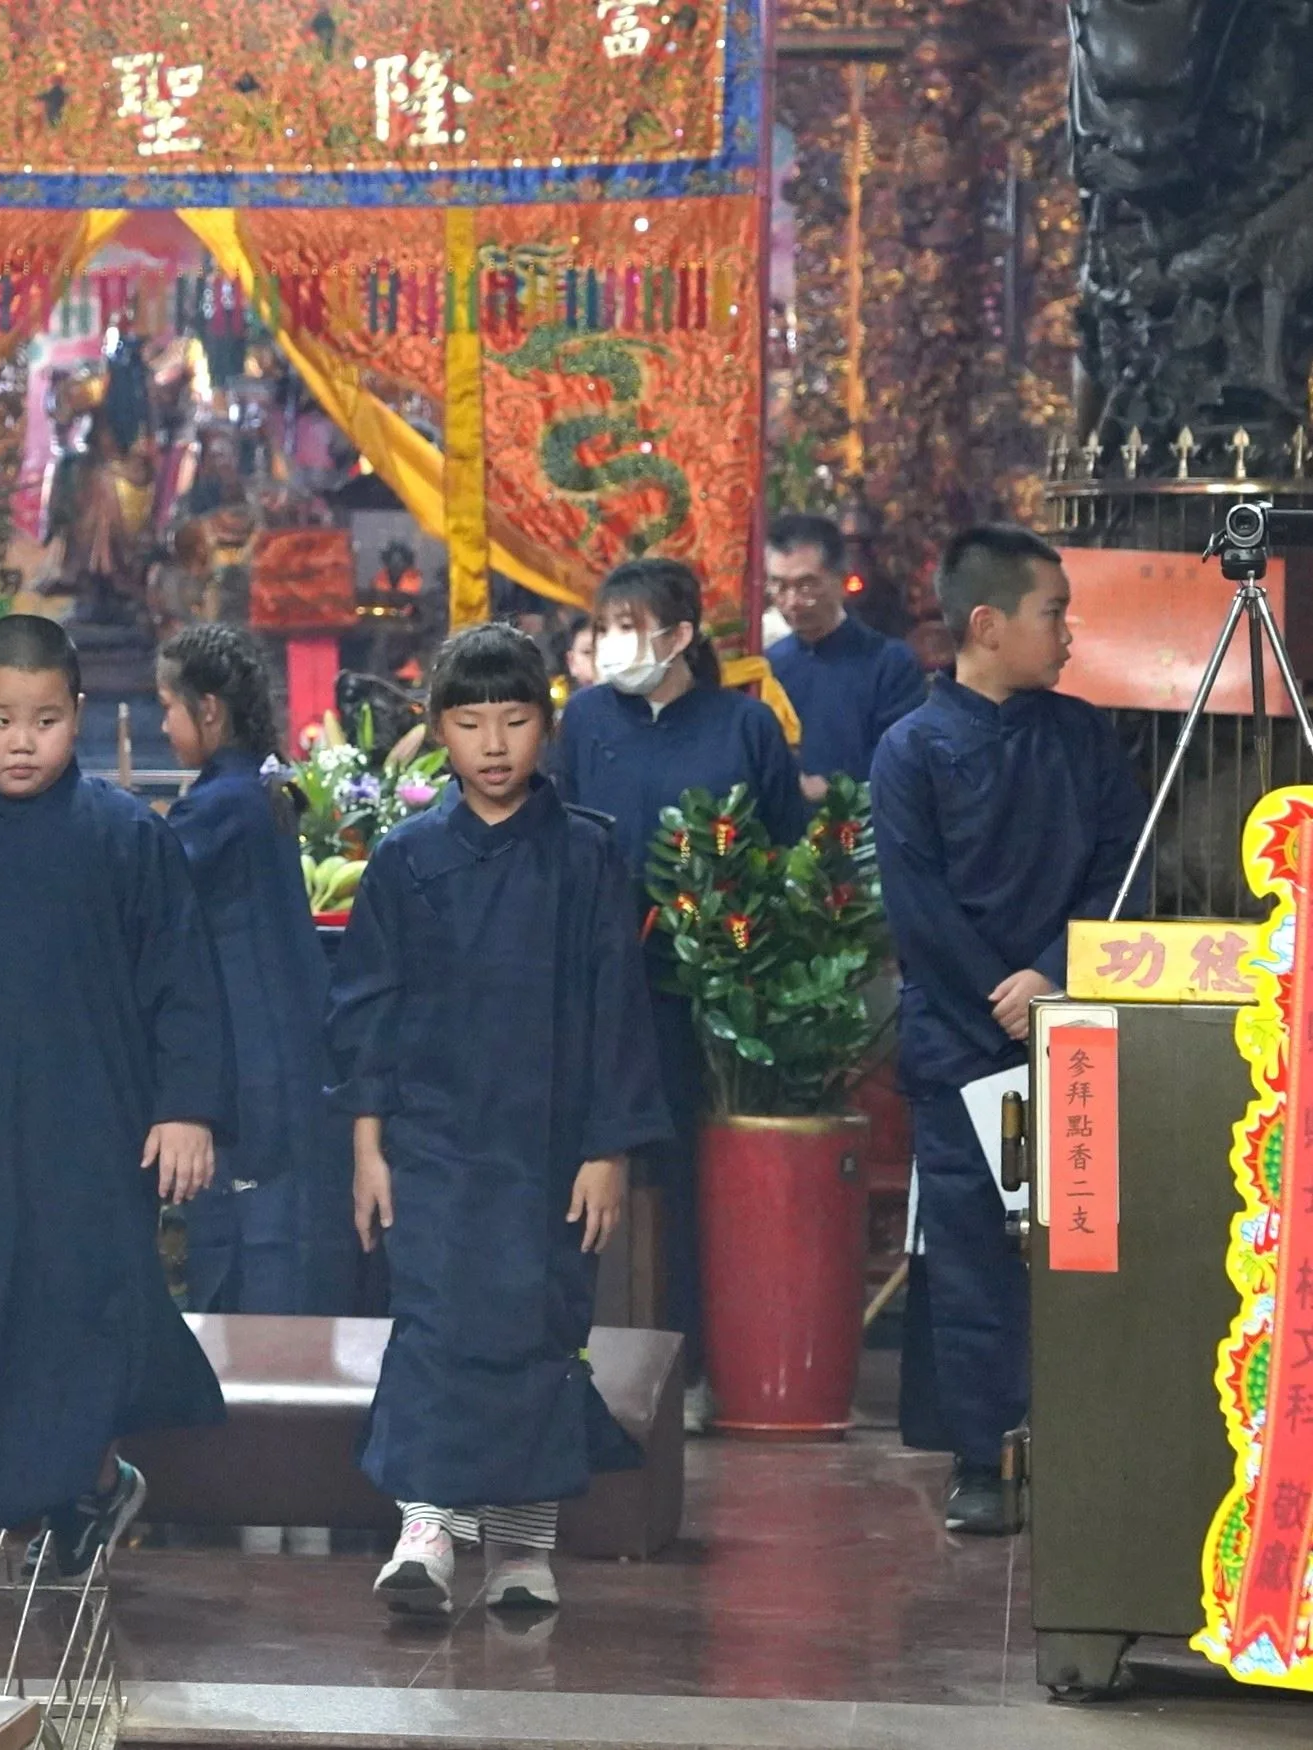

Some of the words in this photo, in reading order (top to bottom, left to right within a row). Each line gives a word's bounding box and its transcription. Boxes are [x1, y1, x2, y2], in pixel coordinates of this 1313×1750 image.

[1065, 1048, 1095, 1235] 參拜點香二支
